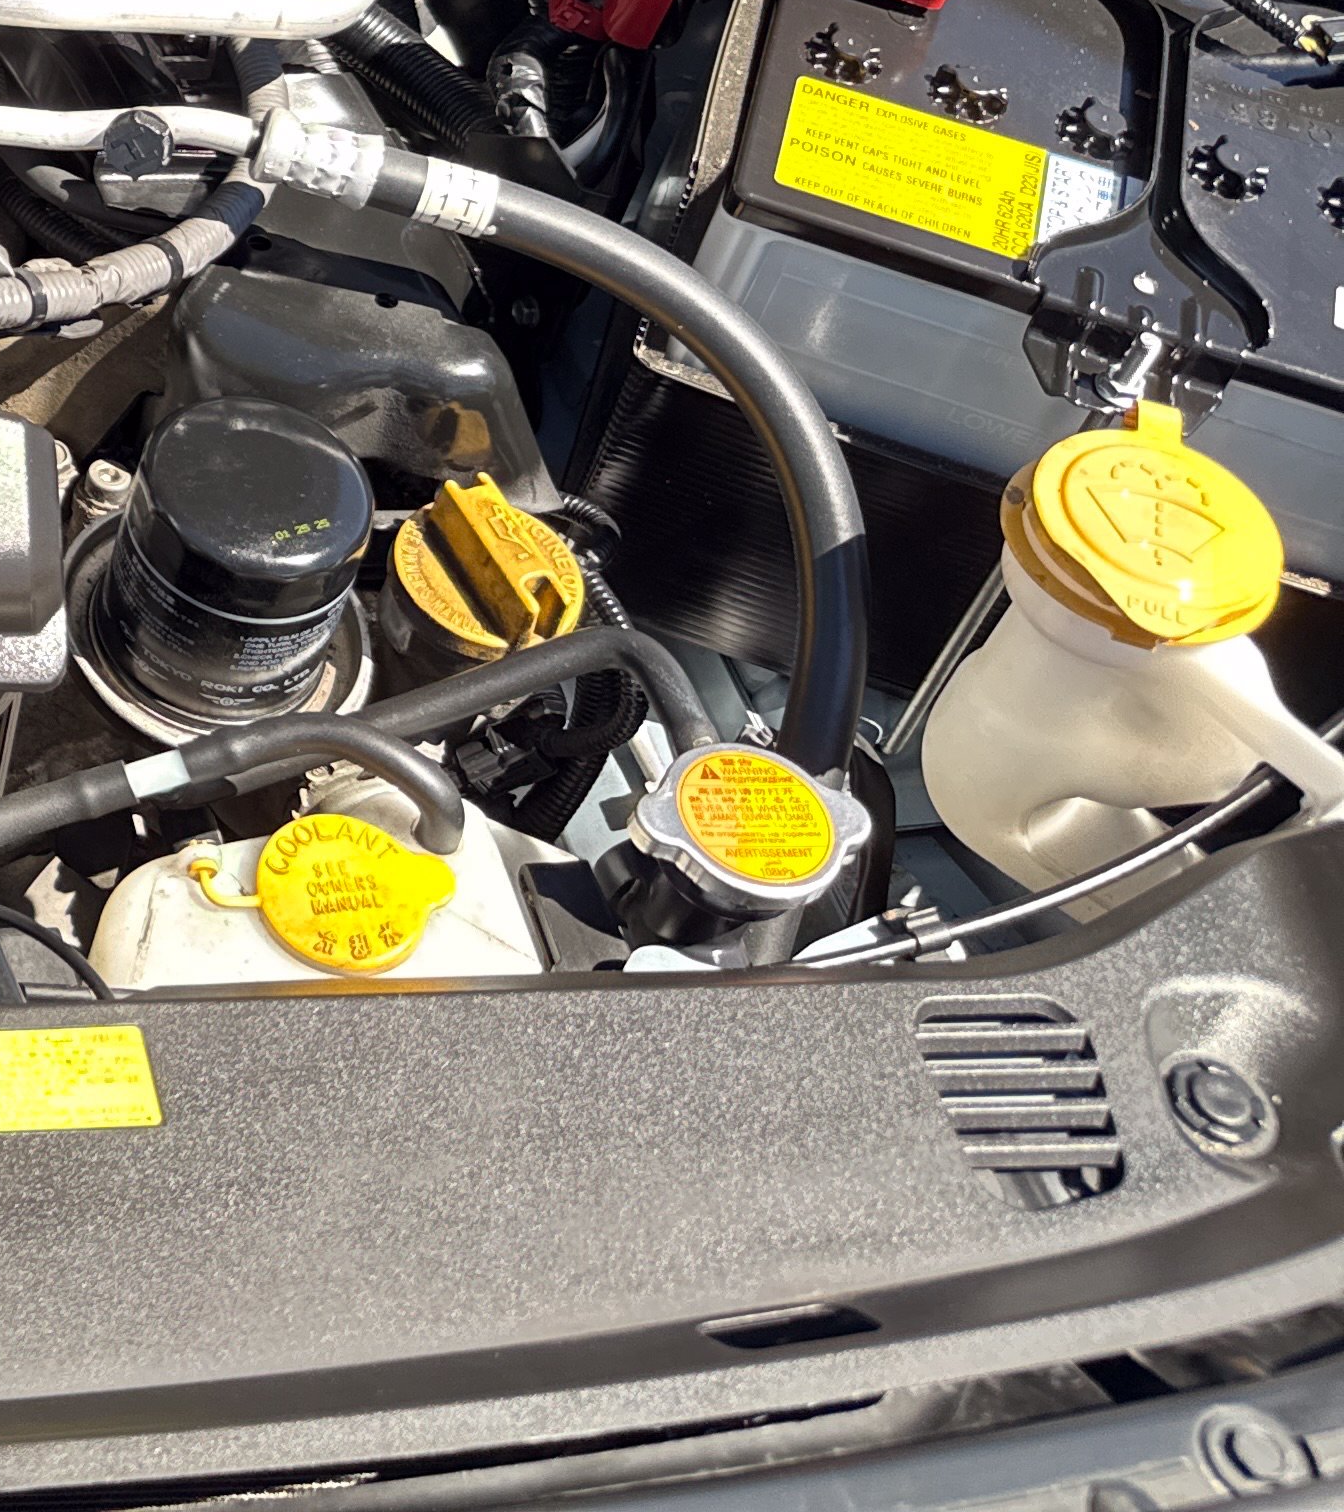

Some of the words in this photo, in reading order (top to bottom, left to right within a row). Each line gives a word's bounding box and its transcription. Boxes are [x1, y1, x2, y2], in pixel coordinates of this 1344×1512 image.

[801, 83, 870, 112] DANGER
[876, 107, 929, 131] EXPLOSIVE
[933, 124, 967, 142] GASES
[789, 137, 857, 167] POISON
[862, 161, 902, 181] CAUSES
[906, 175, 943, 196] SEVERE
[947, 188, 983, 207] BURNS
[806, 127, 831, 142] KEEP
[834, 136, 859, 150] VENT
[863, 145, 889, 161] CAPS
[893, 154, 922, 171] TIGHT
[926, 165, 948, 180] AND
[950, 172, 982, 190] LEVEL
[794, 175, 820, 190] KEEP
[823, 184, 844, 198] OUT
[846, 190, 861, 203] OF
[863, 195, 899, 216] REACH
[901, 206, 915, 220] OF
[917, 212, 972, 240] CHILDREN
[996, 190, 1017, 219] 62Ah
[1016, 200, 1035, 233] 620A
[294, 522, 311, 536] 25
[314, 518, 331, 530] 25
[514, 511, 573, 570] NGINE
[1126, 594, 1189, 627] PULL
[141, 646, 192, 682] TOKYO
[200, 679, 243, 694] ROKI
[720, 766, 777, 776] WARNING
[691, 804, 723, 813] NEVER
[727, 804, 754, 813] OPEN
[757, 804, 787, 813] WHEN
[791, 803, 810, 813] HOT
[264, 821, 400, 876] COOLANT
[724, 847, 813, 858] AVERTISSEMENT
[311, 859, 348, 879] SEE
[310, 892, 384, 916] MANUAL
